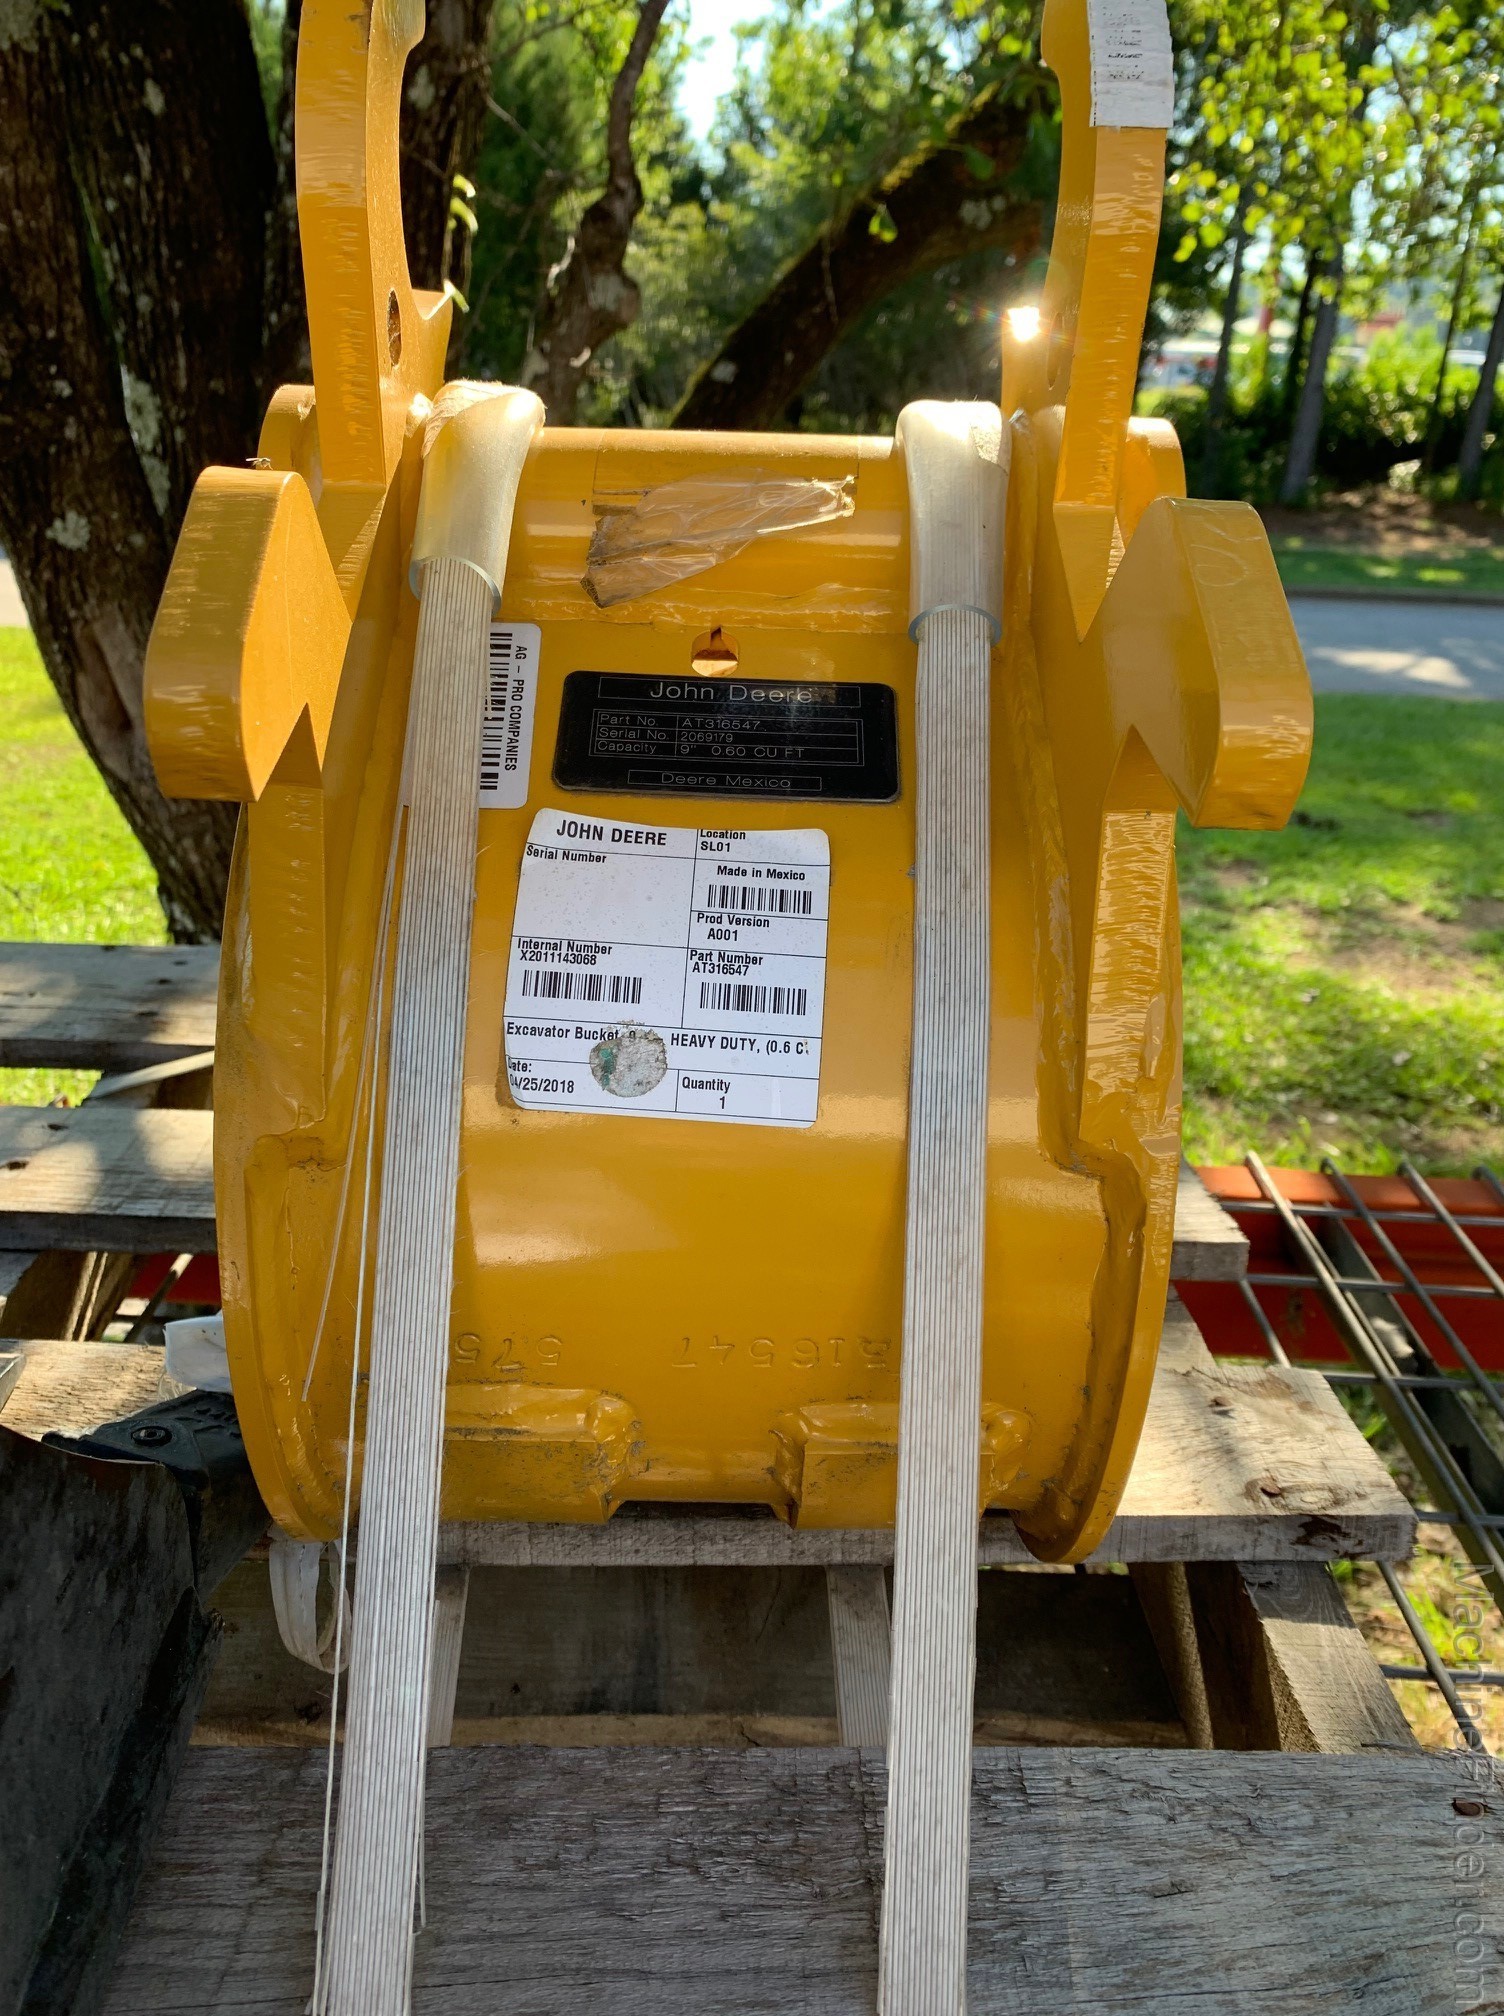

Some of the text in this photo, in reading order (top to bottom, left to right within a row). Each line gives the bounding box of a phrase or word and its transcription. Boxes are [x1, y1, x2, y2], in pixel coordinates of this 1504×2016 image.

[514, 644, 528, 660] AG
[511, 679, 525, 701] PRO
[649, 681, 812, 703] John Deere
[599, 713, 659, 727] Part No.
[681, 717, 761, 731] AT316547
[504, 705, 522, 771] COMPANIES
[598, 727, 670, 741] Serial No.
[680, 731, 734, 743] 2069179
[597, 740, 657, 755] Capacity
[711, 746, 746, 757] 0.60
[754, 747, 777, 758] CU
[785, 748, 805, 758] FT
[661, 772, 791, 788] Deere Mexico
[556, 819, 667, 846] JOHN DEERE
[700, 828, 746, 840] Location
[526, 844, 607, 863] Serial Number
[700, 841, 731, 852] SL01
[717, 865, 805, 881] Made in Mexico
[697, 912, 770, 928] Prod Version
[707, 928, 738, 941] A001
[517, 938, 612, 955] Internal Number
[520, 949, 597, 965] X2011143068
[690, 949, 763, 966] Part Number
[692, 961, 749, 976] AT316547
[506, 1021, 571, 1039] Excavator
[575, 1026, 619, 1042] Bucket
[670, 1032, 716, 1049] HEAVY
[720, 1036, 760, 1054] DUTY,
[766, 1039, 791, 1055] (0.6
[682, 1076, 731, 1094] Quantity
[719, 1096, 726, 1109] 1
